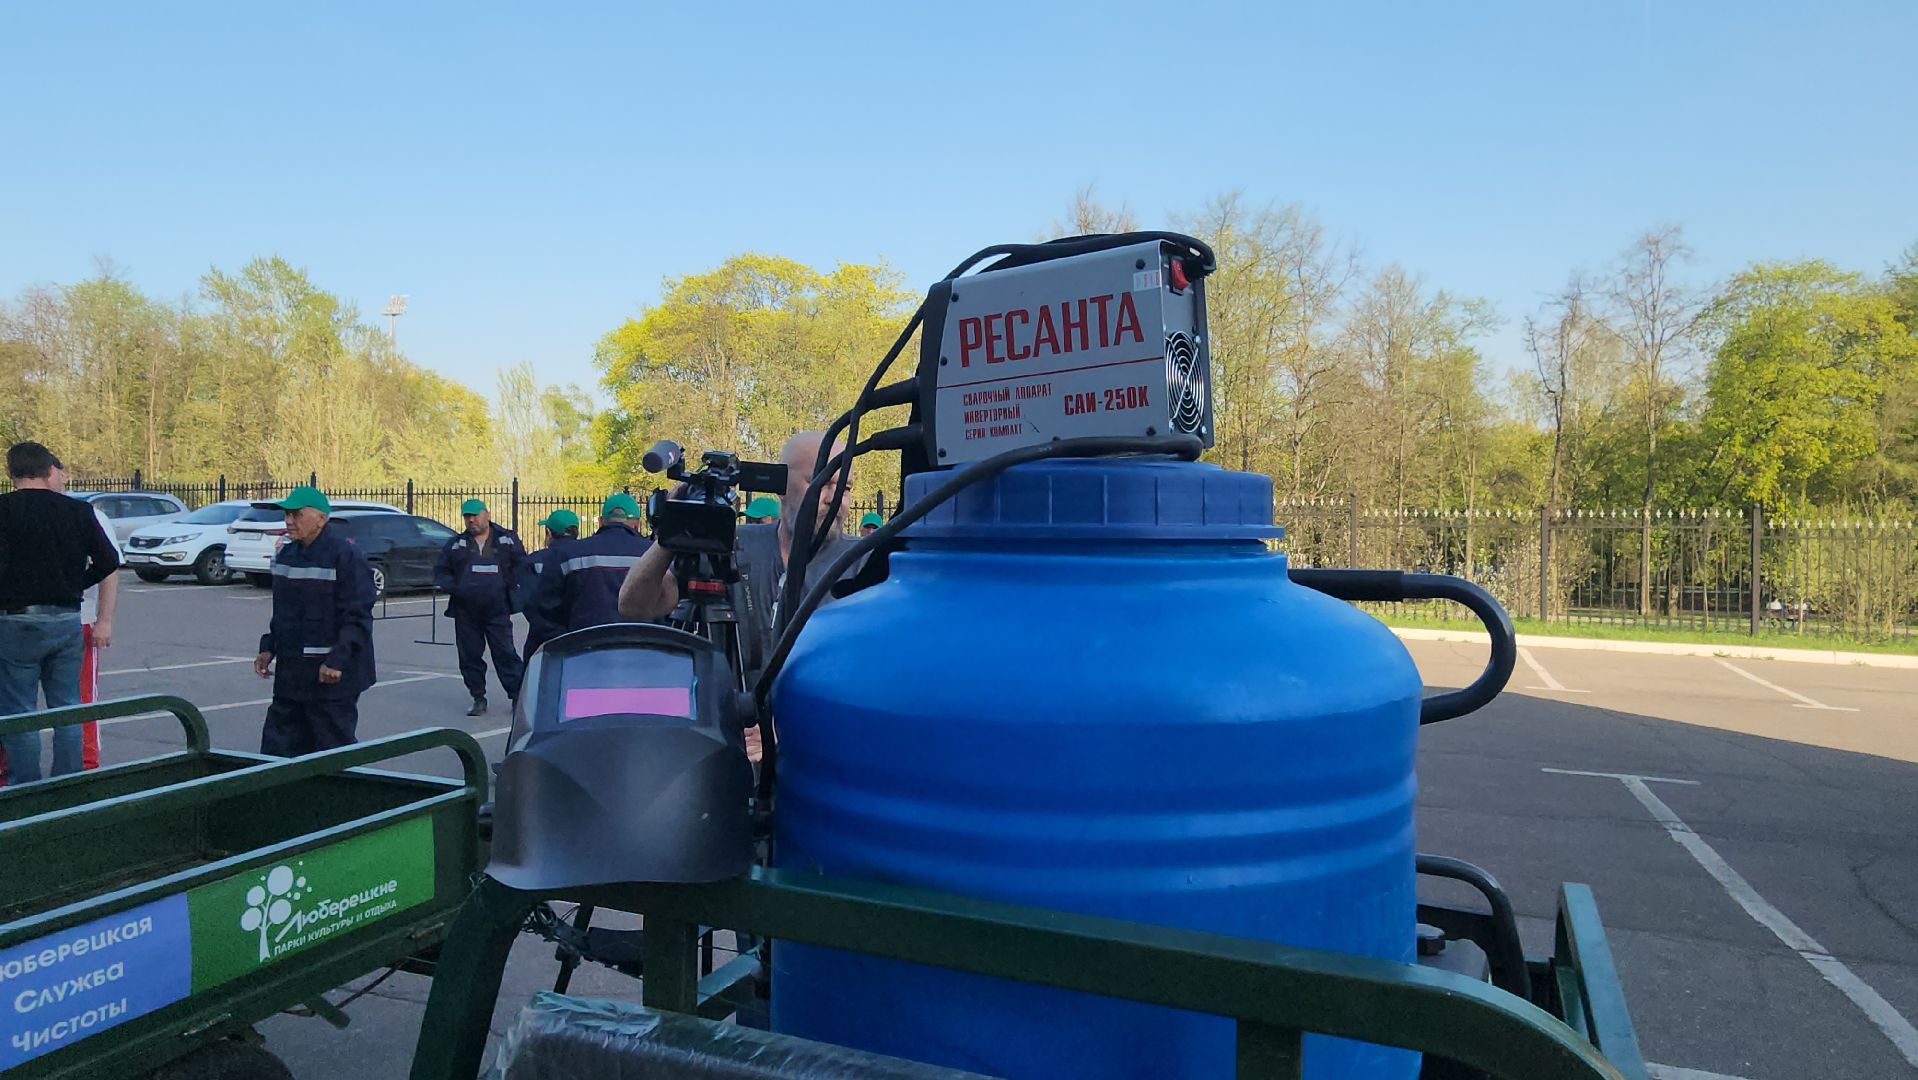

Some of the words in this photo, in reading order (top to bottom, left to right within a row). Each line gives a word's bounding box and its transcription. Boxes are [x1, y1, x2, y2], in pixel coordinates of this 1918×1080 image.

[959, 291, 1144, 367] РЕСАНТА
[963, 386, 1010, 406] СВАРОЧНЫЙ
[1015, 382, 1052, 399] АППАРАТ
[964, 403, 1021, 424] ИНВЕРТОРНЫЙ
[1064, 385, 1149, 416] САИ-250К
[274, 935, 306, 956] ПАРКИ
[308, 916, 354, 941] КУЛЬТУРЫ
[365, 900, 397, 919] ОТДЫХА
[275, 880, 398, 943] Люберецкие
[14, 961, 124, 1013] Служба
[12, 998, 127, 1051] Чистоты
